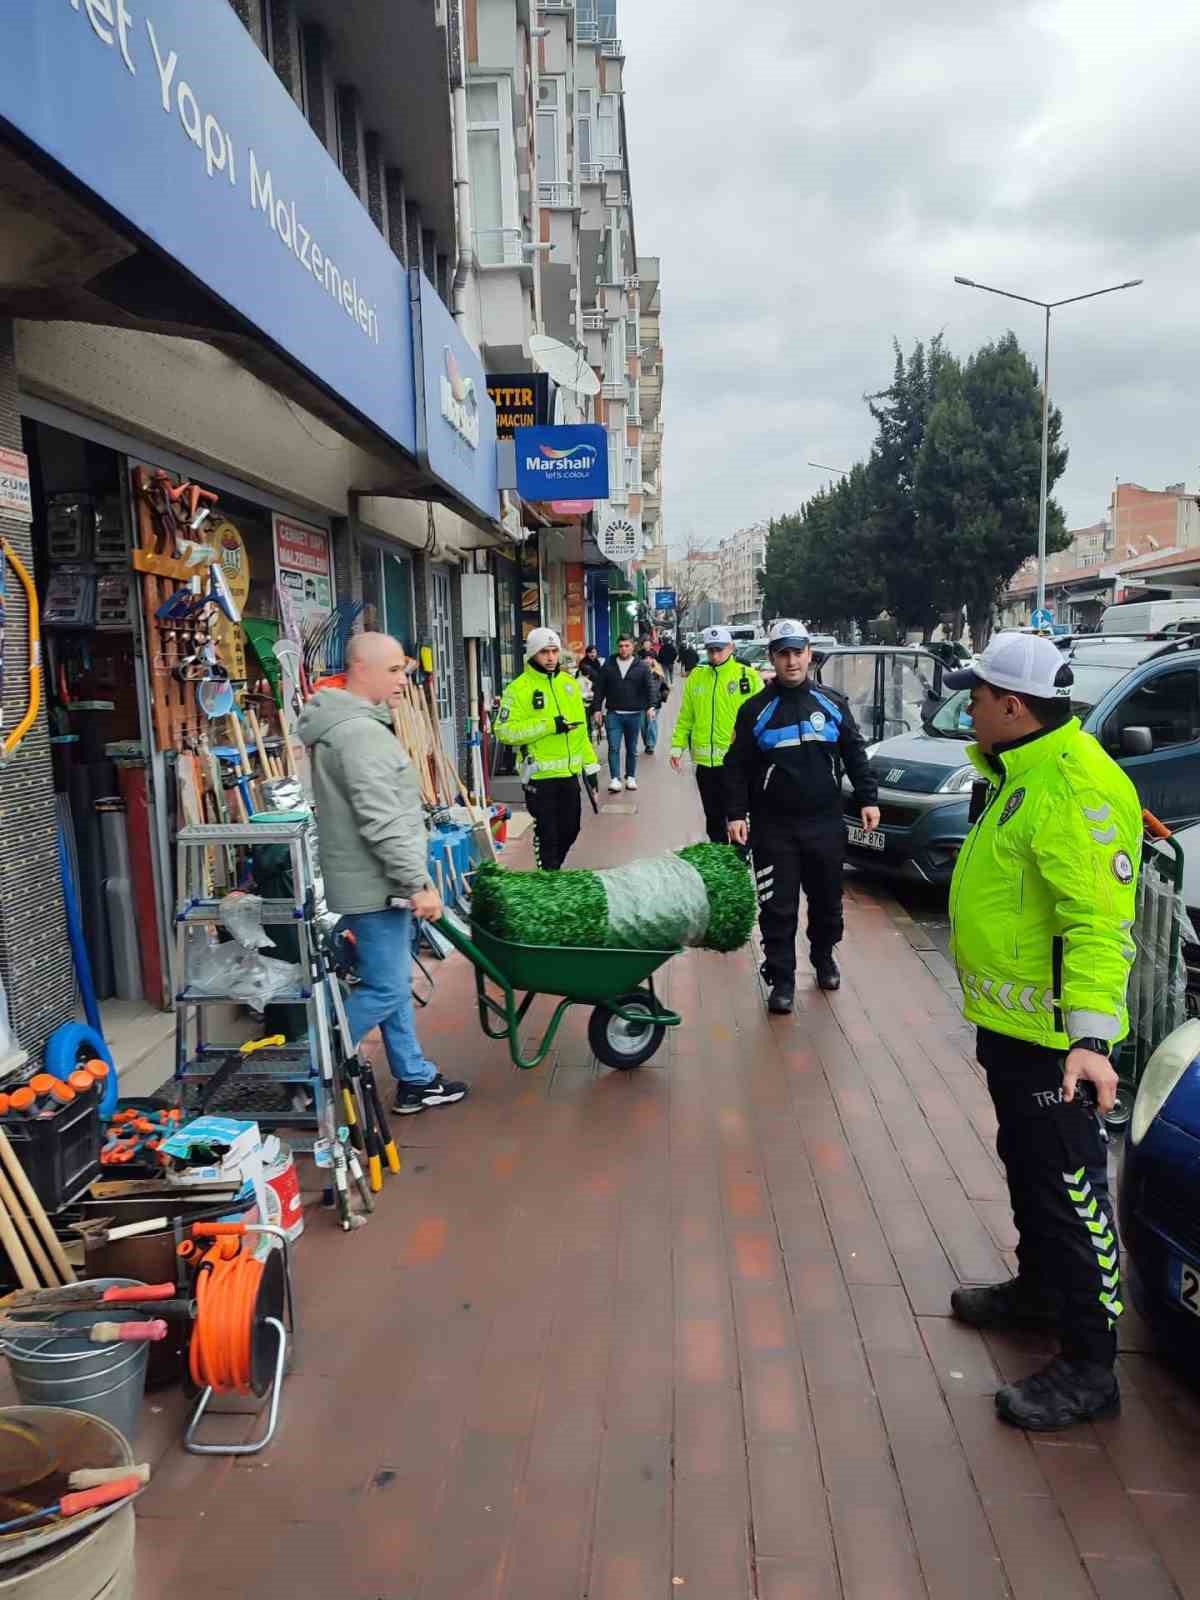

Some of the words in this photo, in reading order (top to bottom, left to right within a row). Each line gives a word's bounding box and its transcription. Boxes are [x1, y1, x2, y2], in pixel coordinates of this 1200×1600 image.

[145, 18, 236, 185] Yapı
[249, 149, 380, 344] Malzemeleri
[526, 457, 590, 470] Marshall
[563, 471, 590, 479] colour
